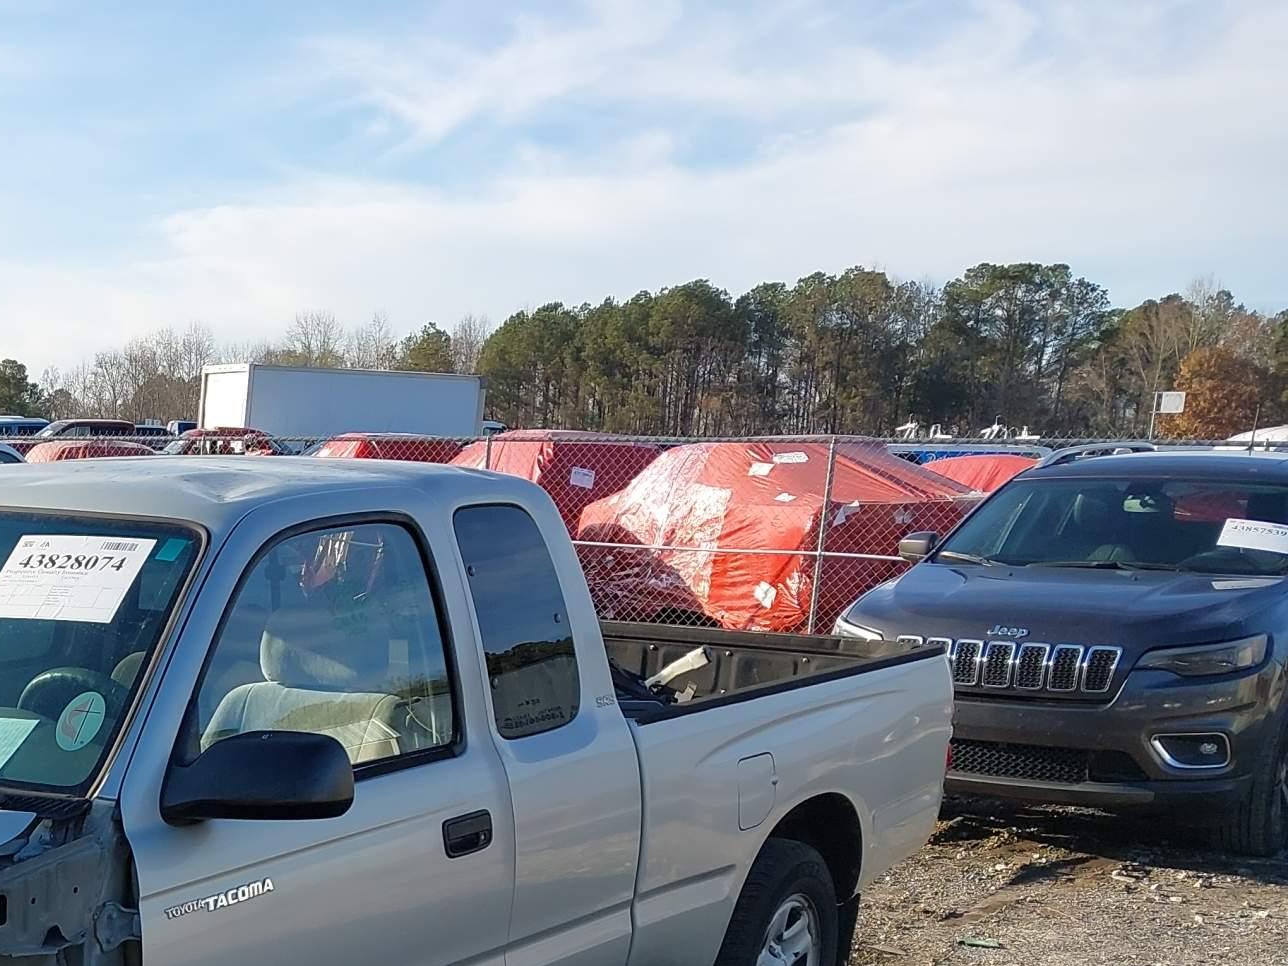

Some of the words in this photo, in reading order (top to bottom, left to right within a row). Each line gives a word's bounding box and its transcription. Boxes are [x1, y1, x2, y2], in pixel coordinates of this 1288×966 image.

[18, 553, 128, 572] 43828074
[985, 624, 1030, 639] Jeep
[164, 899, 206, 919] TOYOTA
[201, 877, 275, 912] TACOMA
